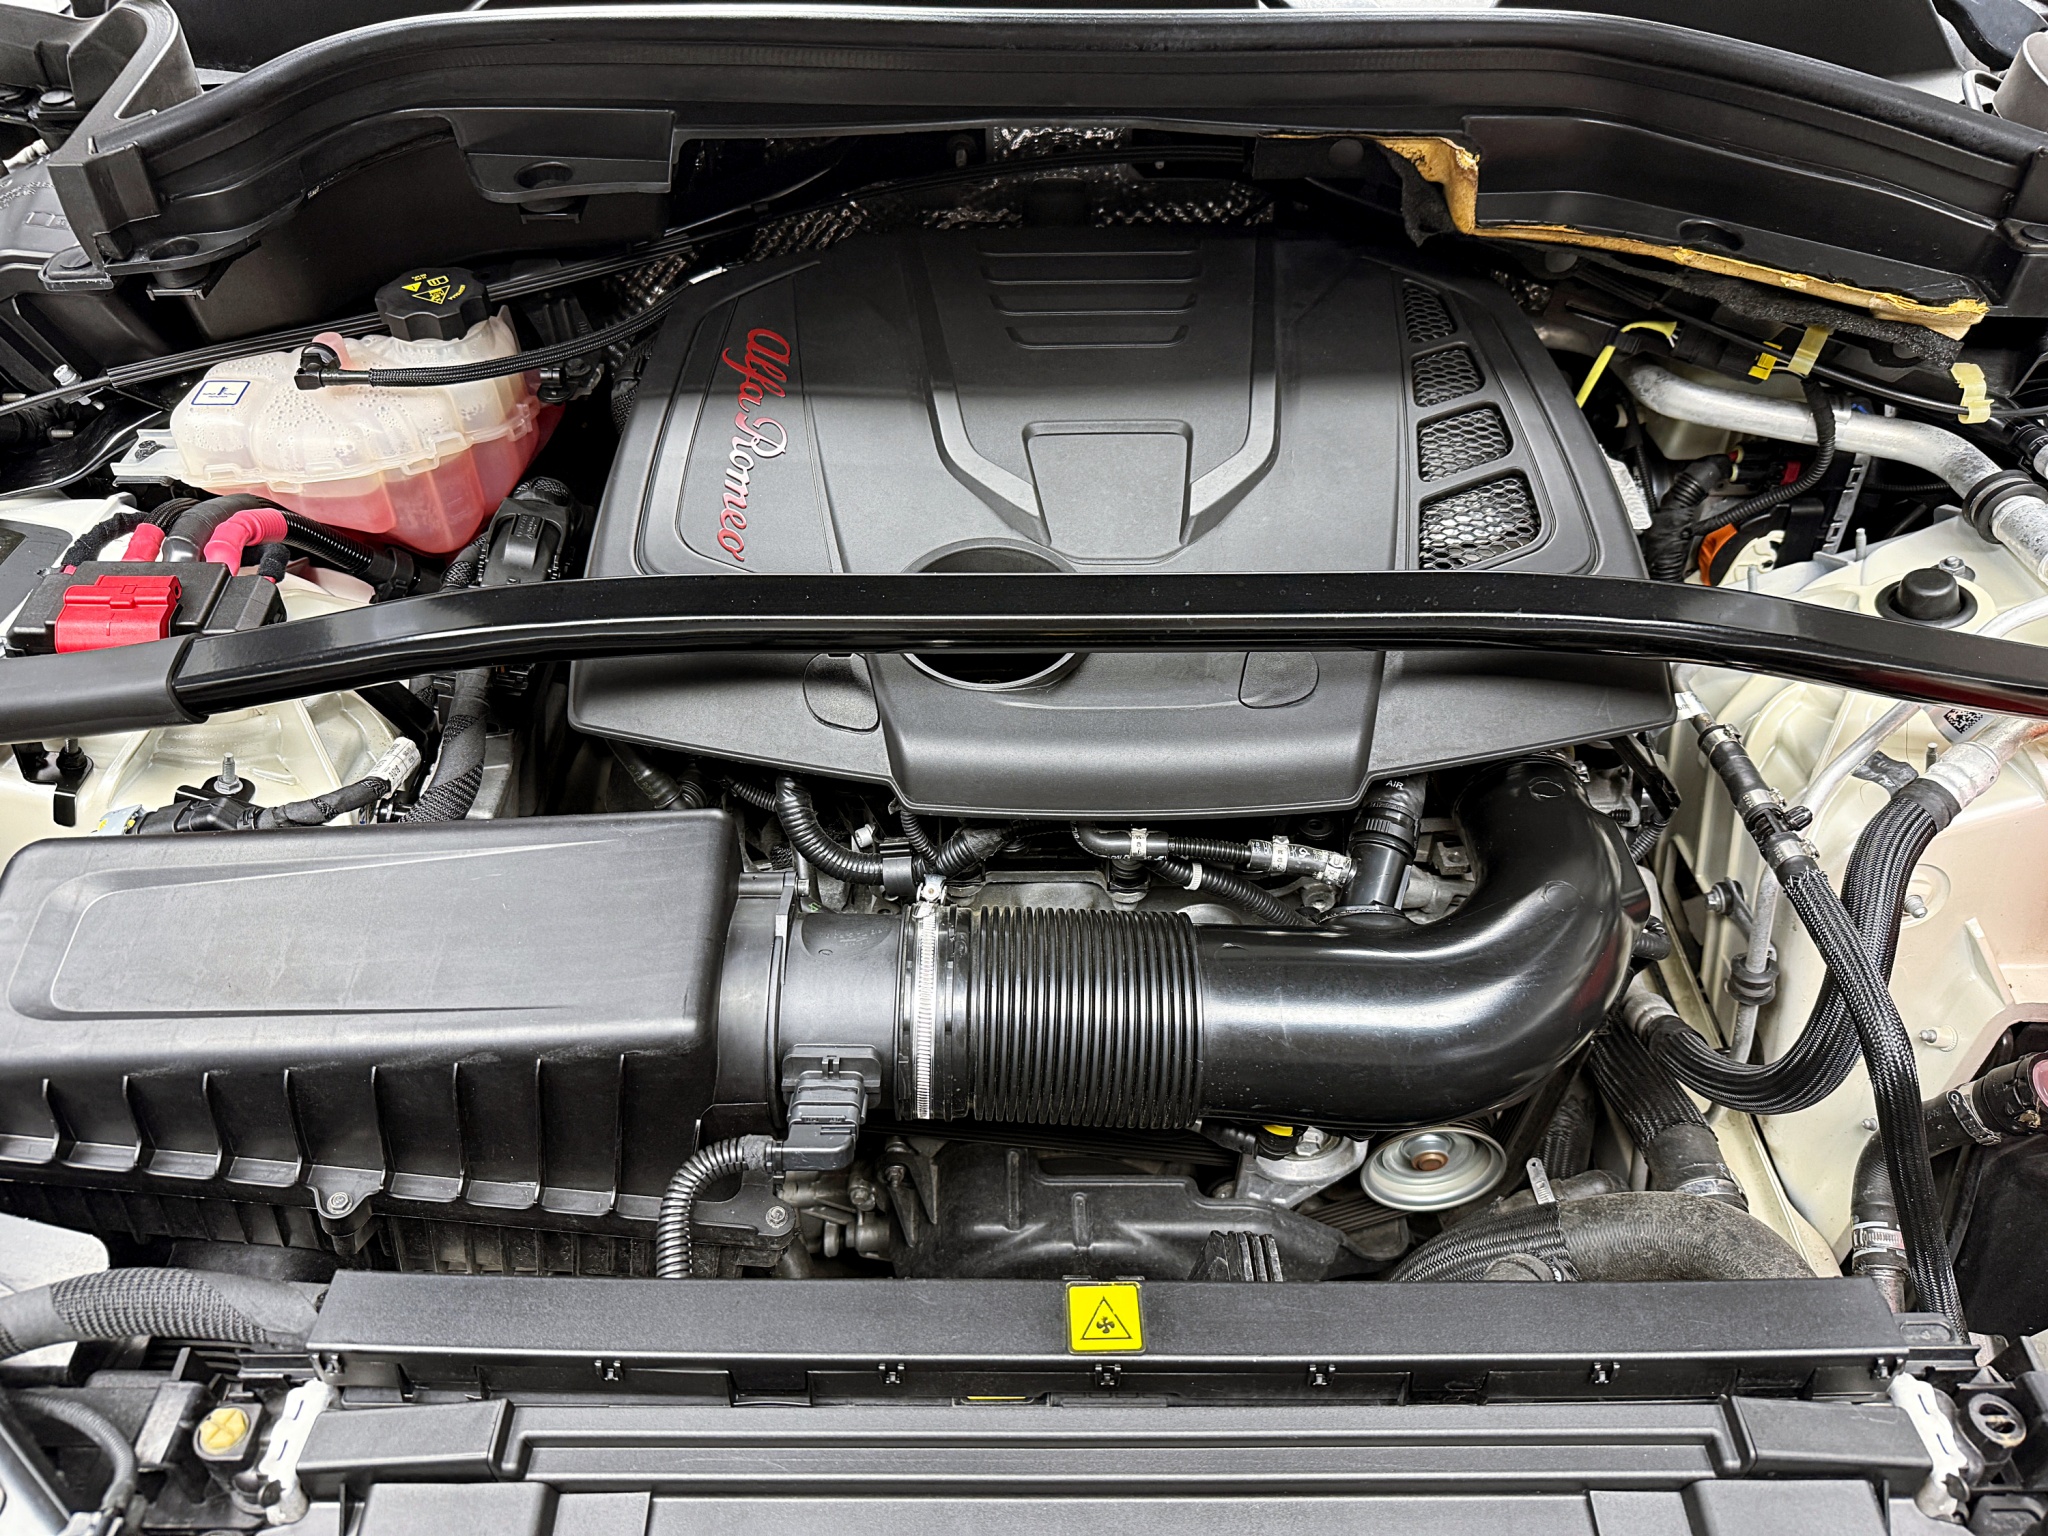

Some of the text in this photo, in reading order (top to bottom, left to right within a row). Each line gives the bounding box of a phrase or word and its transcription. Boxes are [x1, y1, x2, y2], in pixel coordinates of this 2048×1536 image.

[717, 328, 791, 561] Alfa Romeo
[1385, 780, 1404, 790] AIR
